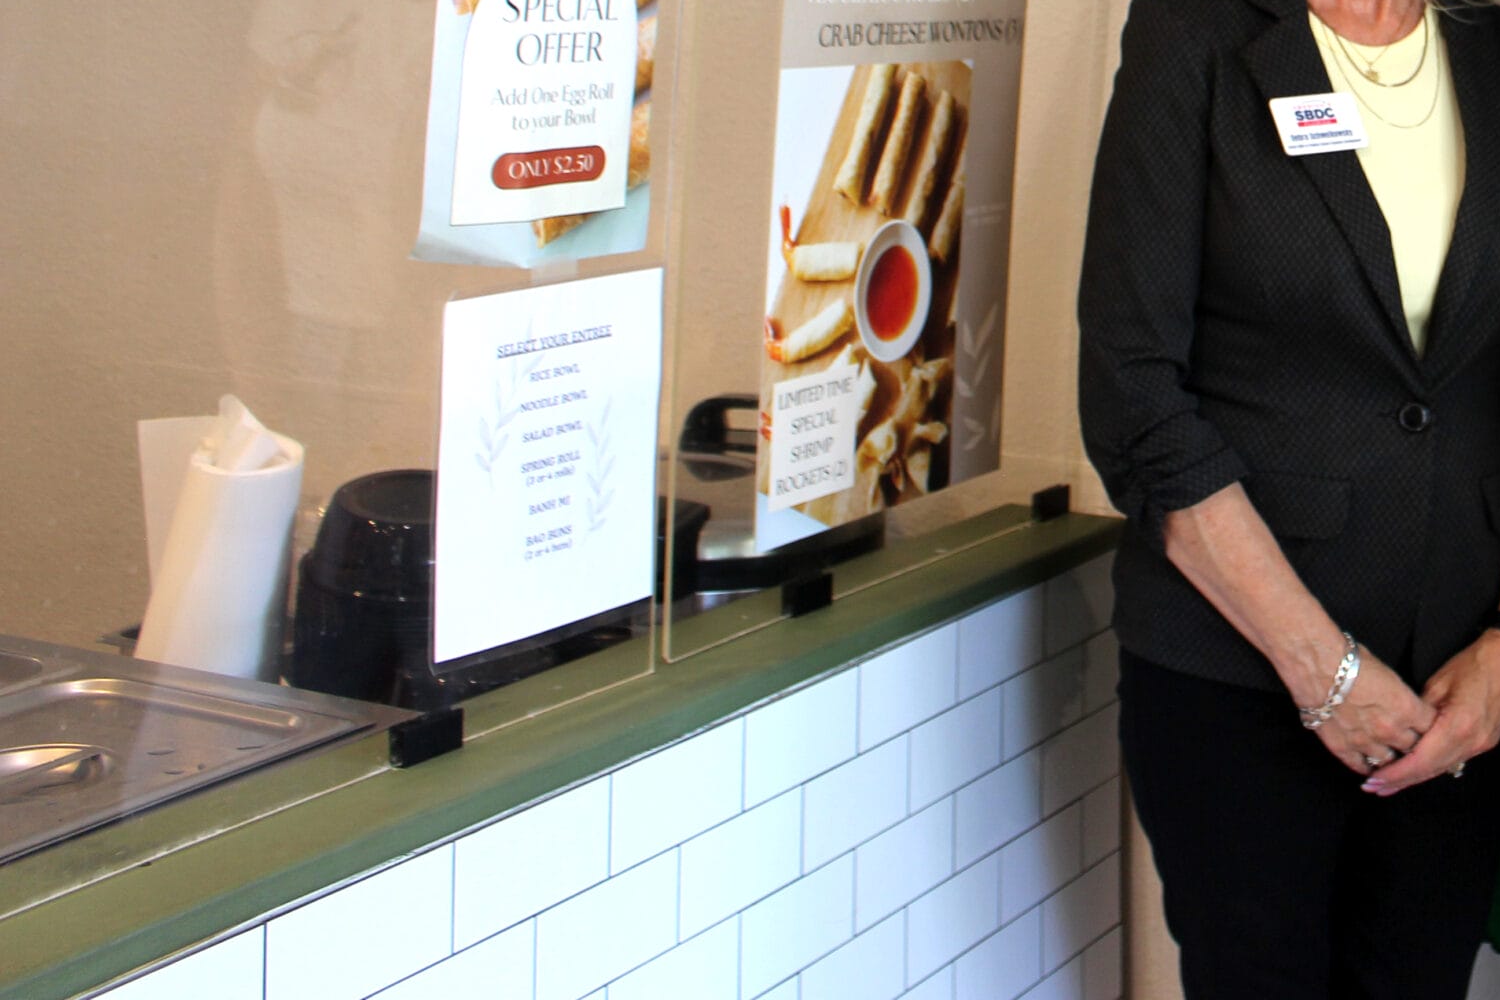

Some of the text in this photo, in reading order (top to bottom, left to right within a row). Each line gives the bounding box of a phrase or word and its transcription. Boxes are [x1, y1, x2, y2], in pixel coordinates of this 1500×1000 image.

[818, 23, 863, 48] CRAB
[866, 21, 927, 47] CHEESE
[928, 19, 1003, 43] WONTONS
[516, 31, 603, 66] OFFER
[491, 82, 615, 106] Add One Egg Roll
[511, 107, 597, 133] to your Bowl
[1294, 107, 1336, 122] SBDC
[508, 153, 595, 180] ONLY $2.50
[497, 324, 613, 359] SELECT YOUR ENTREE
[528, 362, 581, 383] RICE BOWL
[520, 389, 588, 413] NOODLE BOWL
[777, 376, 854, 412] LIMITED TIME
[522, 420, 583, 443] SALAD BOWL
[790, 408, 837, 436] SPECIAL
[520, 450, 581, 474] SPRING ROLL
[790, 436, 834, 464] SHRIMP
[775, 464, 831, 497] ROCKETS
[528, 498, 557, 516] BANH
[526, 524, 572, 548] BAO BUNS
